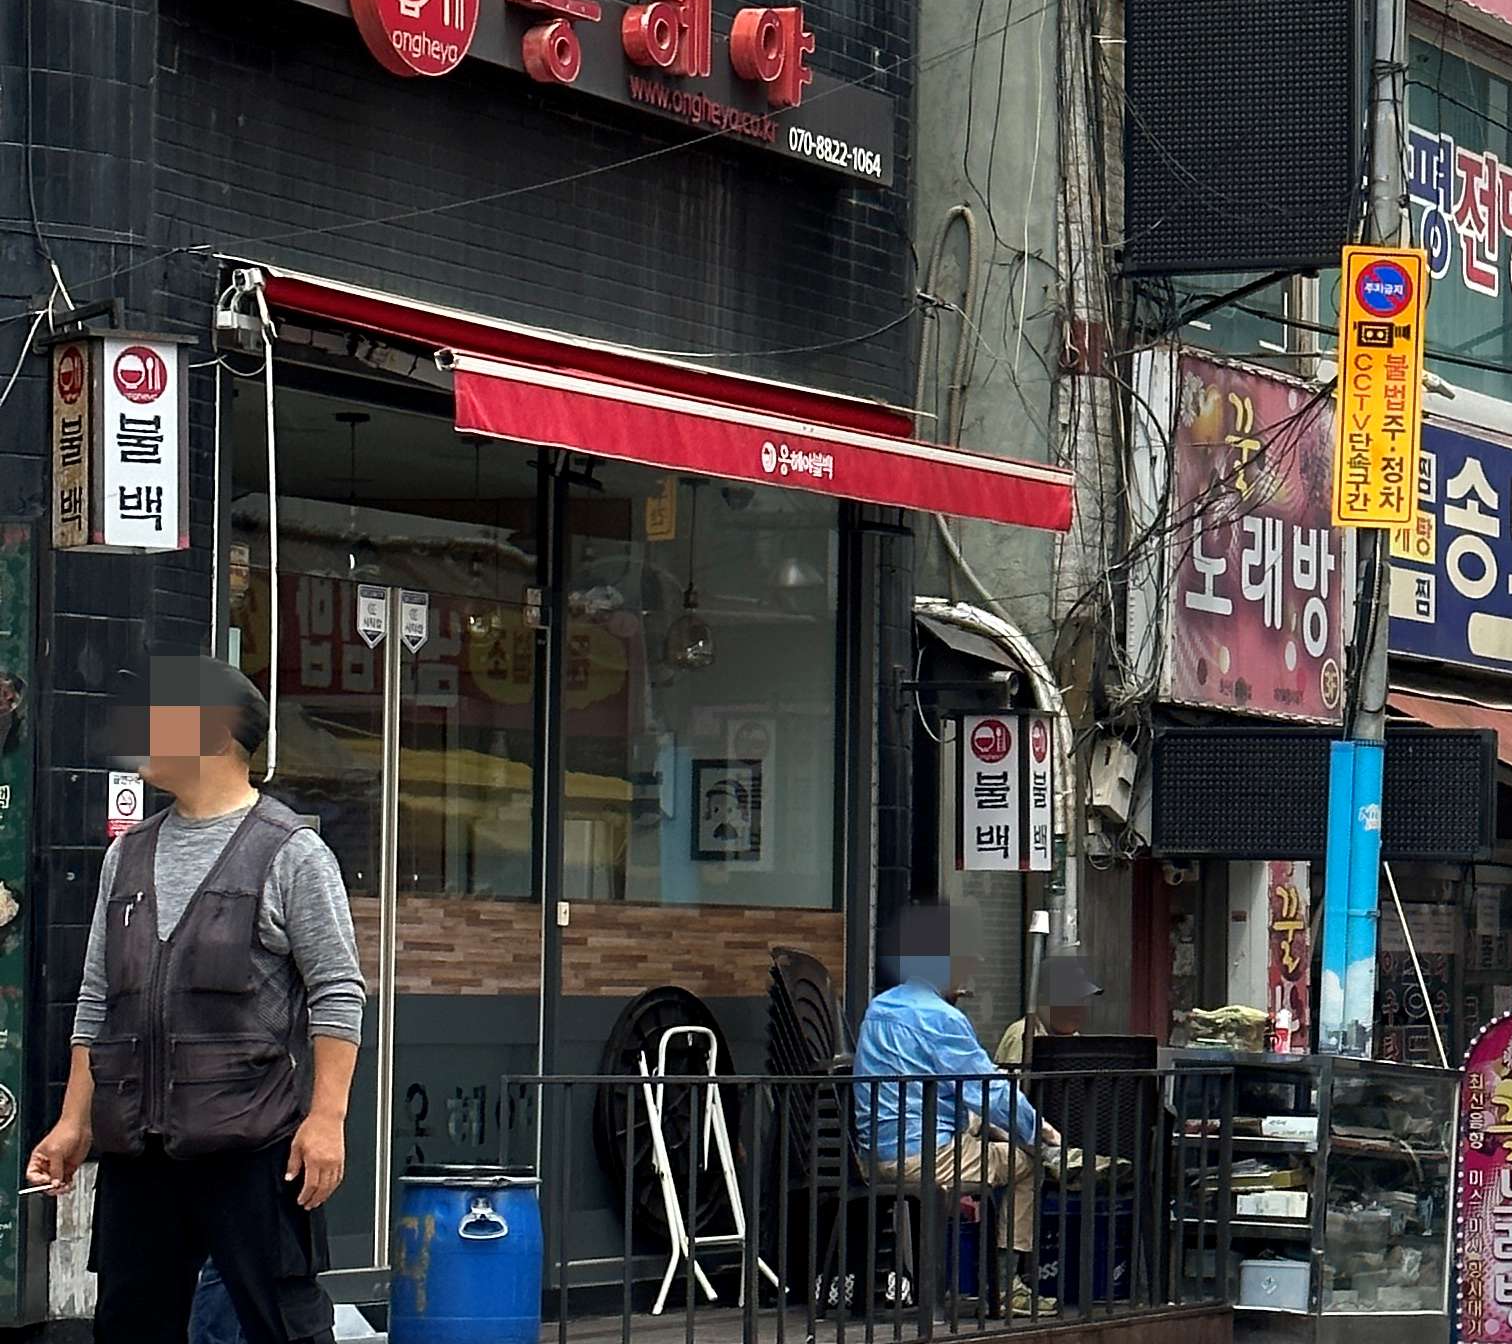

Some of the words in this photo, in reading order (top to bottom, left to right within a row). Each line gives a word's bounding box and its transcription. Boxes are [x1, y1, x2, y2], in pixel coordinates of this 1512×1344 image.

[392, 28, 458, 63] ongheya
[788, 127, 882, 178] 070-8822-1064
[1185, 503, 1335, 658] 노래방
